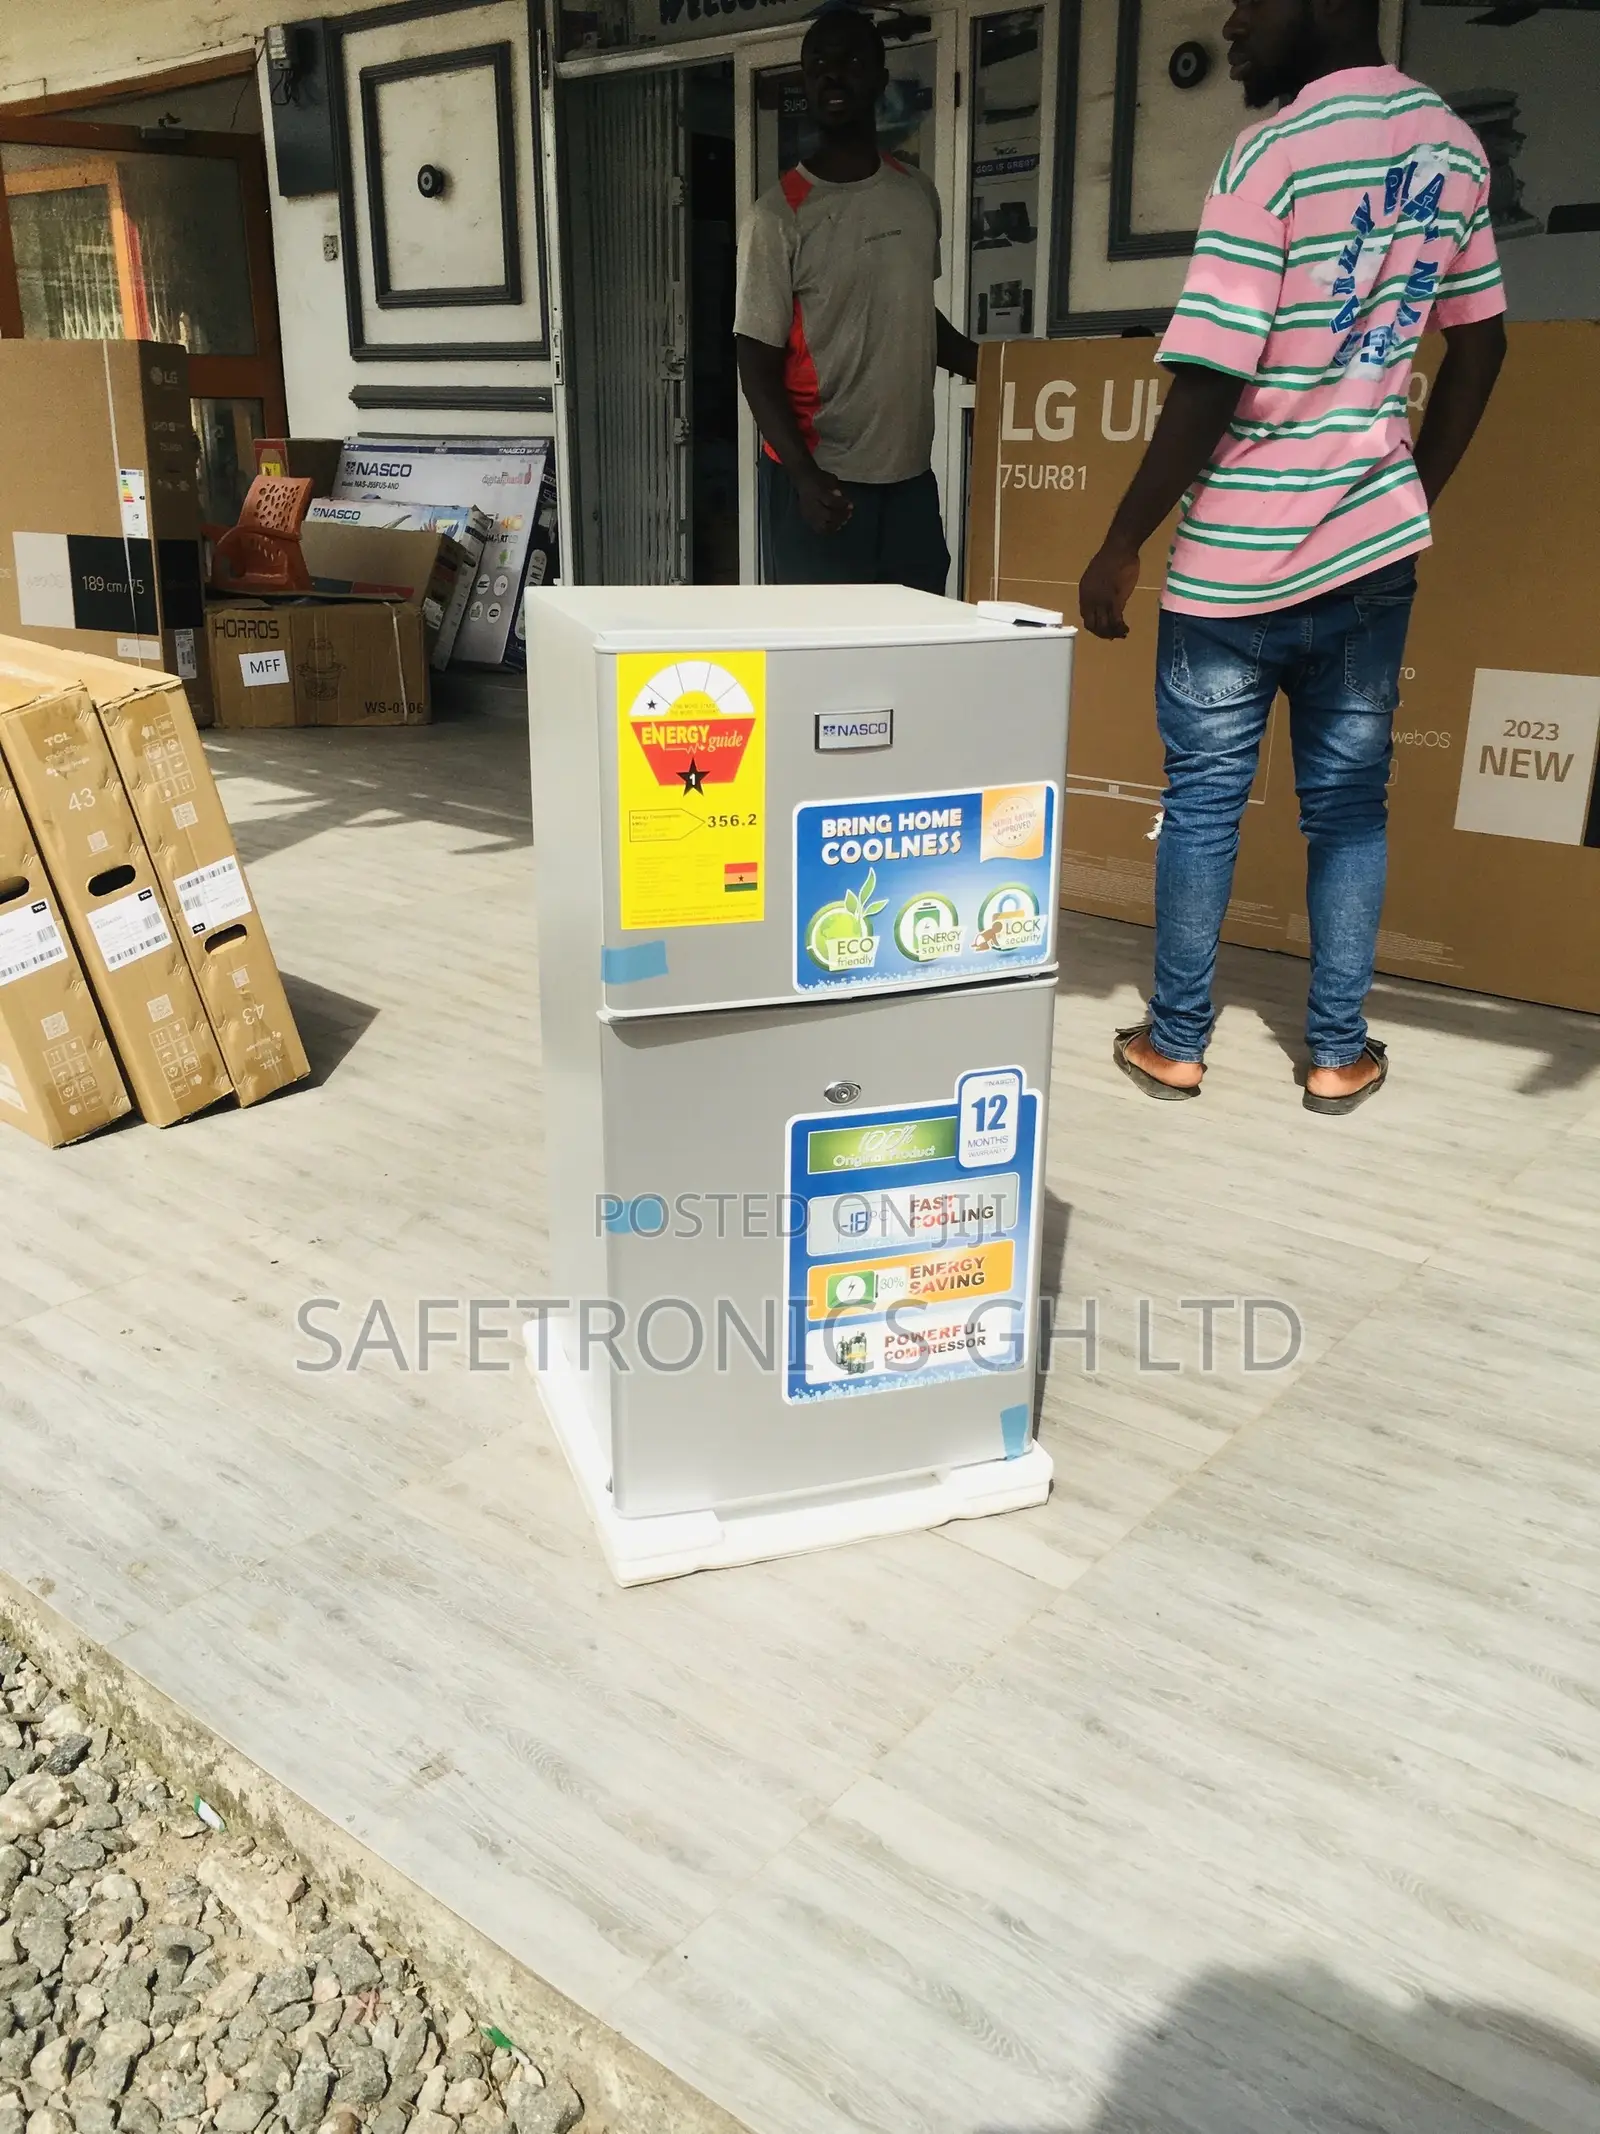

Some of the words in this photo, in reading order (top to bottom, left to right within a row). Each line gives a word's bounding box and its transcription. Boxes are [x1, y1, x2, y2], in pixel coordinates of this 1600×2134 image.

[163, 370, 179, 385] LG
[1001, 380, 1077, 441] LG
[355, 461, 412, 478] NASCO
[1000, 464, 1088, 491] 75UR81
[319, 507, 361, 521] NASCO
[82, 575, 104, 592] 189
[214, 618, 279, 640] HORROS
[250, 658, 280, 674] MFF
[43, 732, 73, 746] TCL
[641, 722, 710, 751] ENERGY
[708, 731, 743, 752] guide
[838, 722, 888, 737] NASCO
[1391, 729, 1451, 748] webOS
[1503, 719, 1559, 741] 2023
[1479, 745, 1575, 783] NEW
[689, 773, 696, 786] 1
[69, 787, 95, 811] 43
[707, 813, 757, 828] 356.2
[821, 814, 892, 839] BRING
[898, 808, 962, 832] HOME
[821, 831, 962, 866] COOLNESS
[1005, 919, 1041, 935] LOCK
[921, 930, 962, 945] ENERGY
[1005, 933, 1041, 946] security
[837, 939, 874, 956] ECO
[921, 941, 961, 955] saving
[837, 953, 874, 967] friendly
[971, 1094, 1008, 1132] 12
[967, 1135, 1009, 1149] MONTHS
[833, 1149, 884, 1168] Original
[889, 1144, 936, 1162] Product
[910, 1193, 957, 1212] FAST
[910, 1205, 994, 1229] COOLING
[910, 1256, 986, 1279] ENERGY
[880, 1276, 904, 1290] 30%
[910, 1271, 985, 1294] SAVING
[884, 1322, 986, 1347] POWERFUL
[884, 1336, 986, 1361] COMPRESSOR
